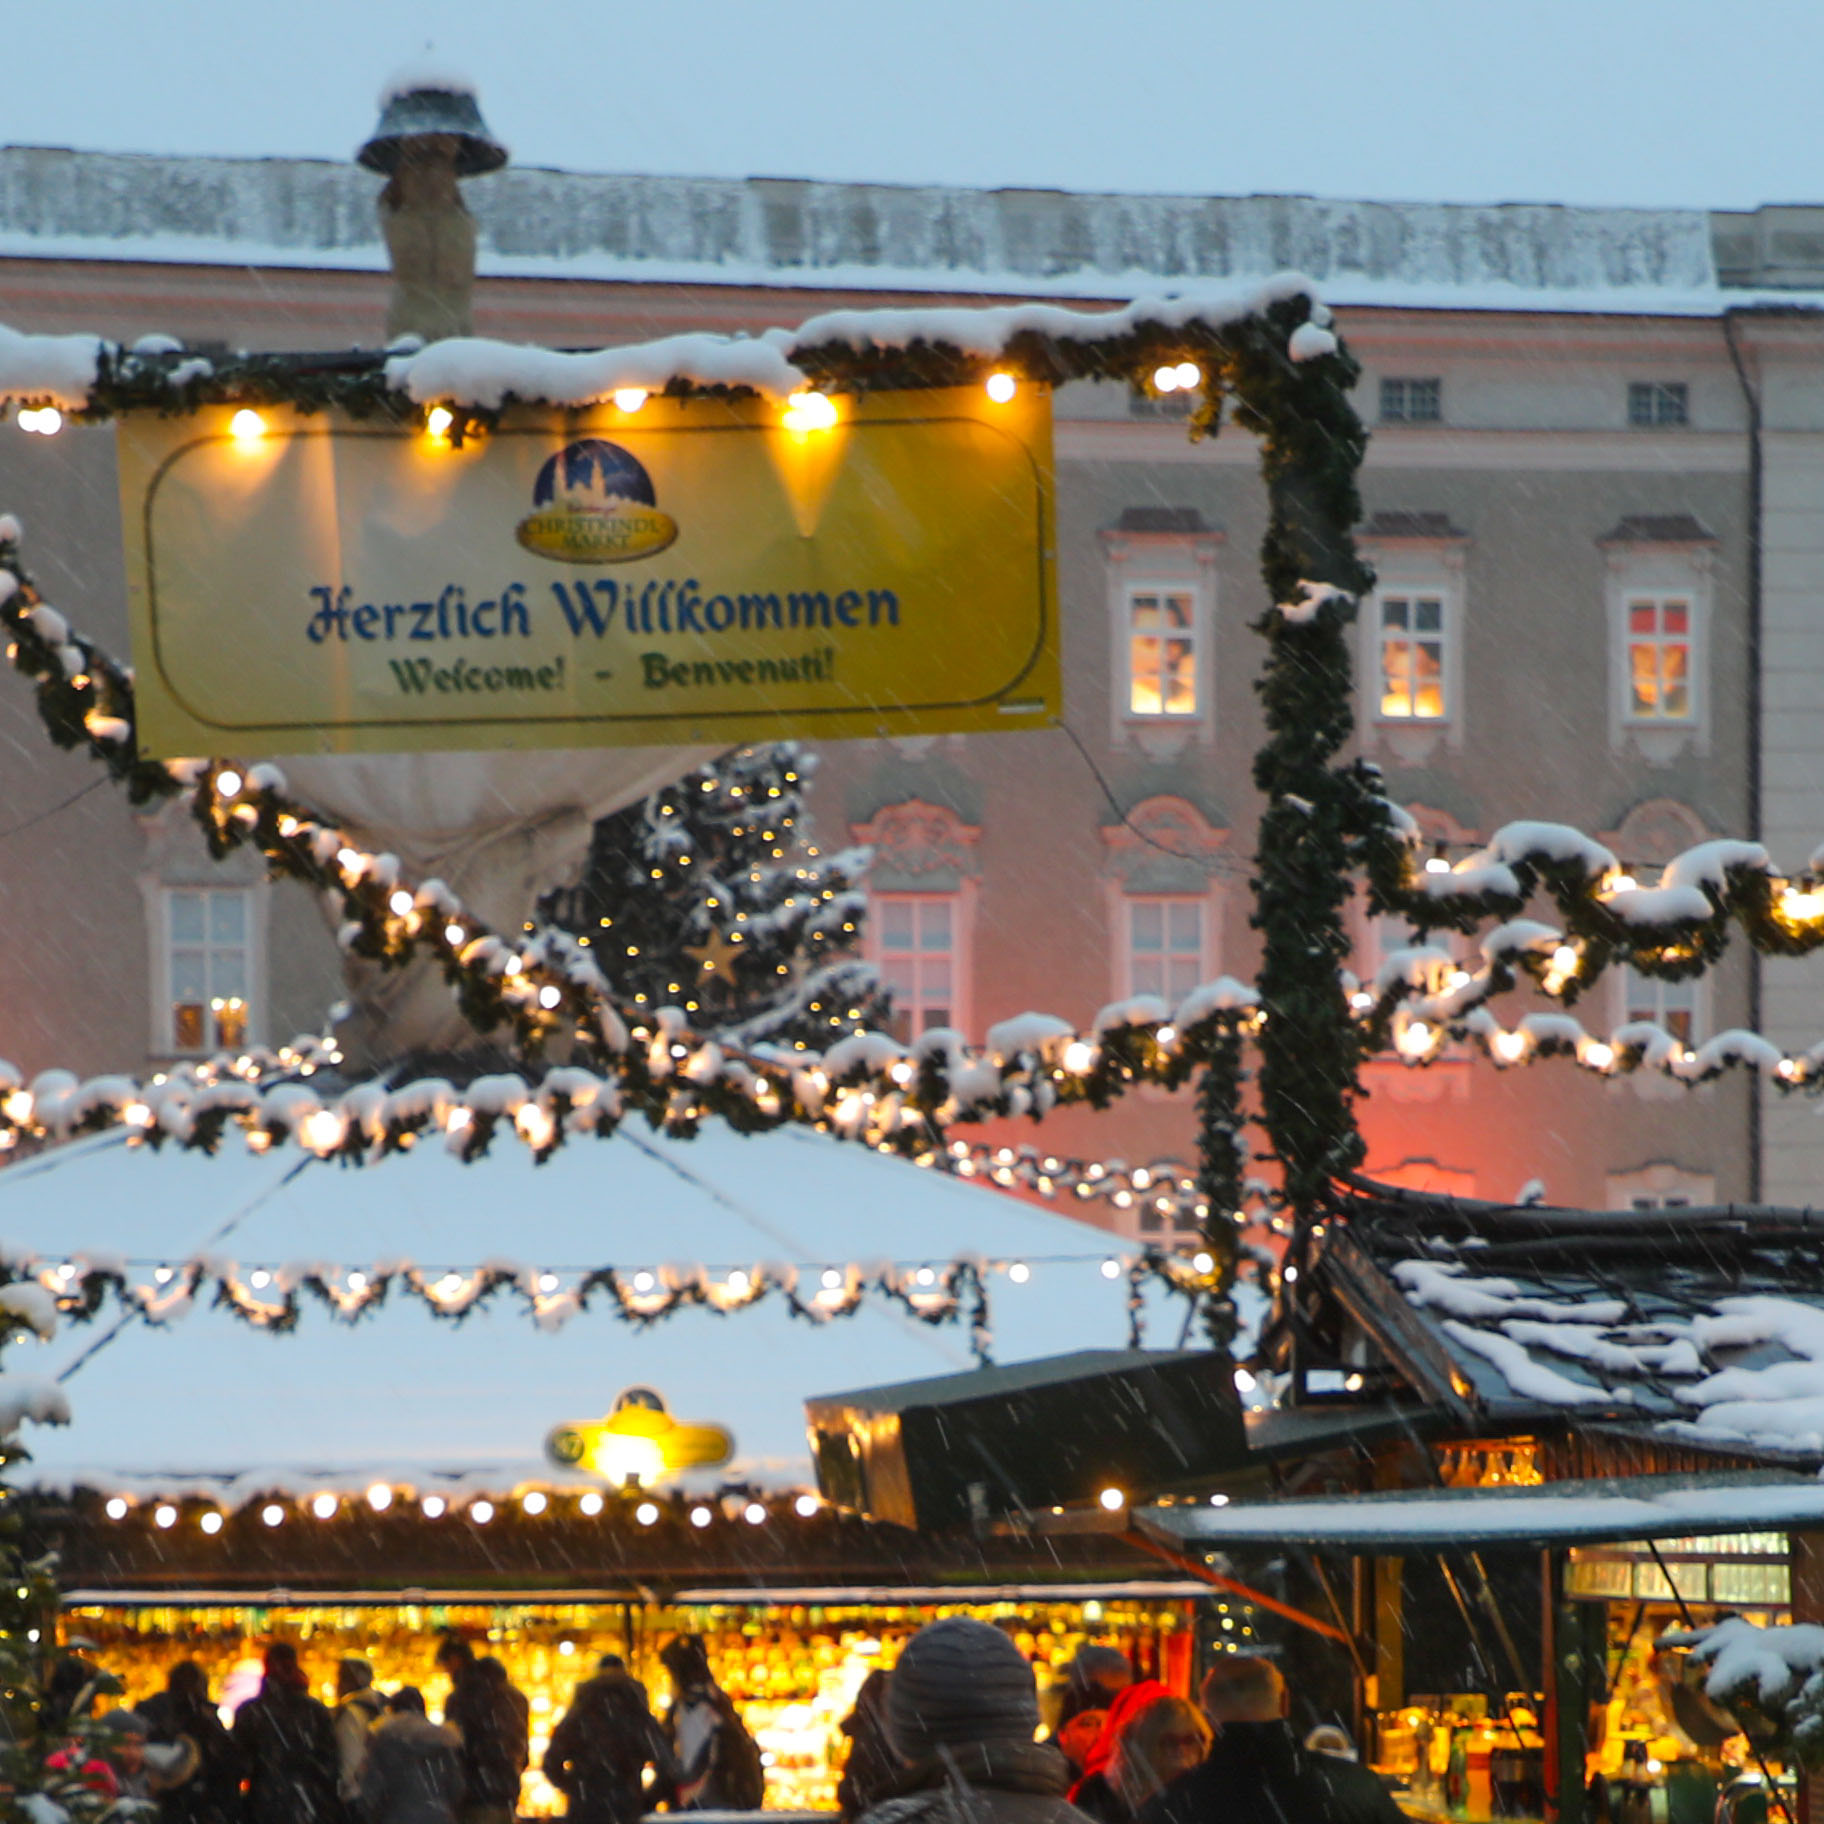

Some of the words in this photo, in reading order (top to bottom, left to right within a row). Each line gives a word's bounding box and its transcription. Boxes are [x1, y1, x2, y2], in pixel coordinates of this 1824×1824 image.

[563, 534, 631, 549] MARKT
[306, 583, 531, 643] Herzlich
[550, 578, 901, 638] Willkommen
[388, 655, 566, 694] Welcome!
[640, 647, 835, 690] Benvenuti!
